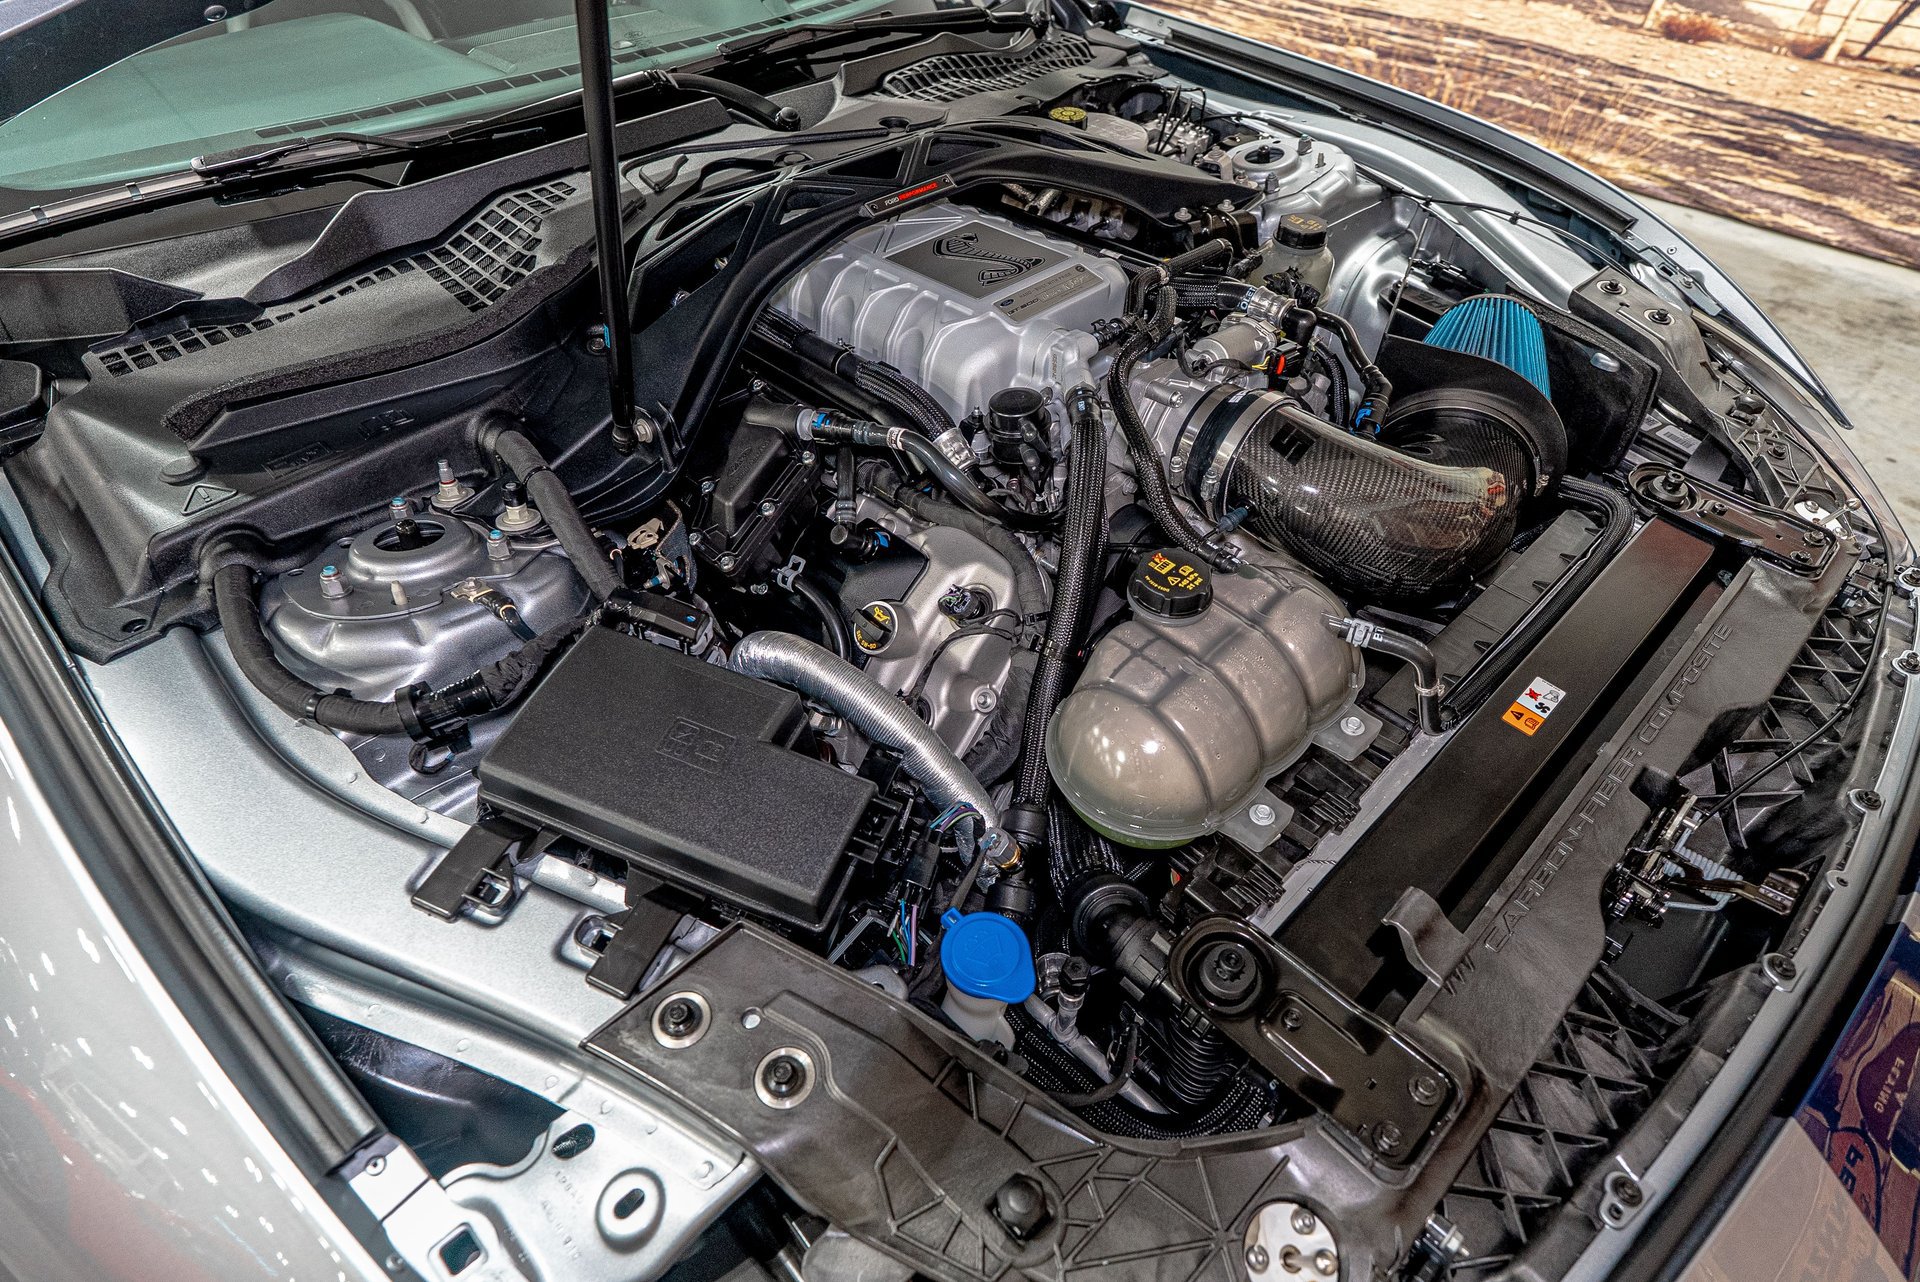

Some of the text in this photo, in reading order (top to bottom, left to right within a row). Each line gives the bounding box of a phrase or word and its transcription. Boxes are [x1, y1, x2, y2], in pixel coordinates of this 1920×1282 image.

[884, 182, 938, 207] FORD PERFORMANCE
[1020, 298, 1039, 309] 500
[1484, 622, 1734, 953] CARBON-FIBER COMPOSITE
